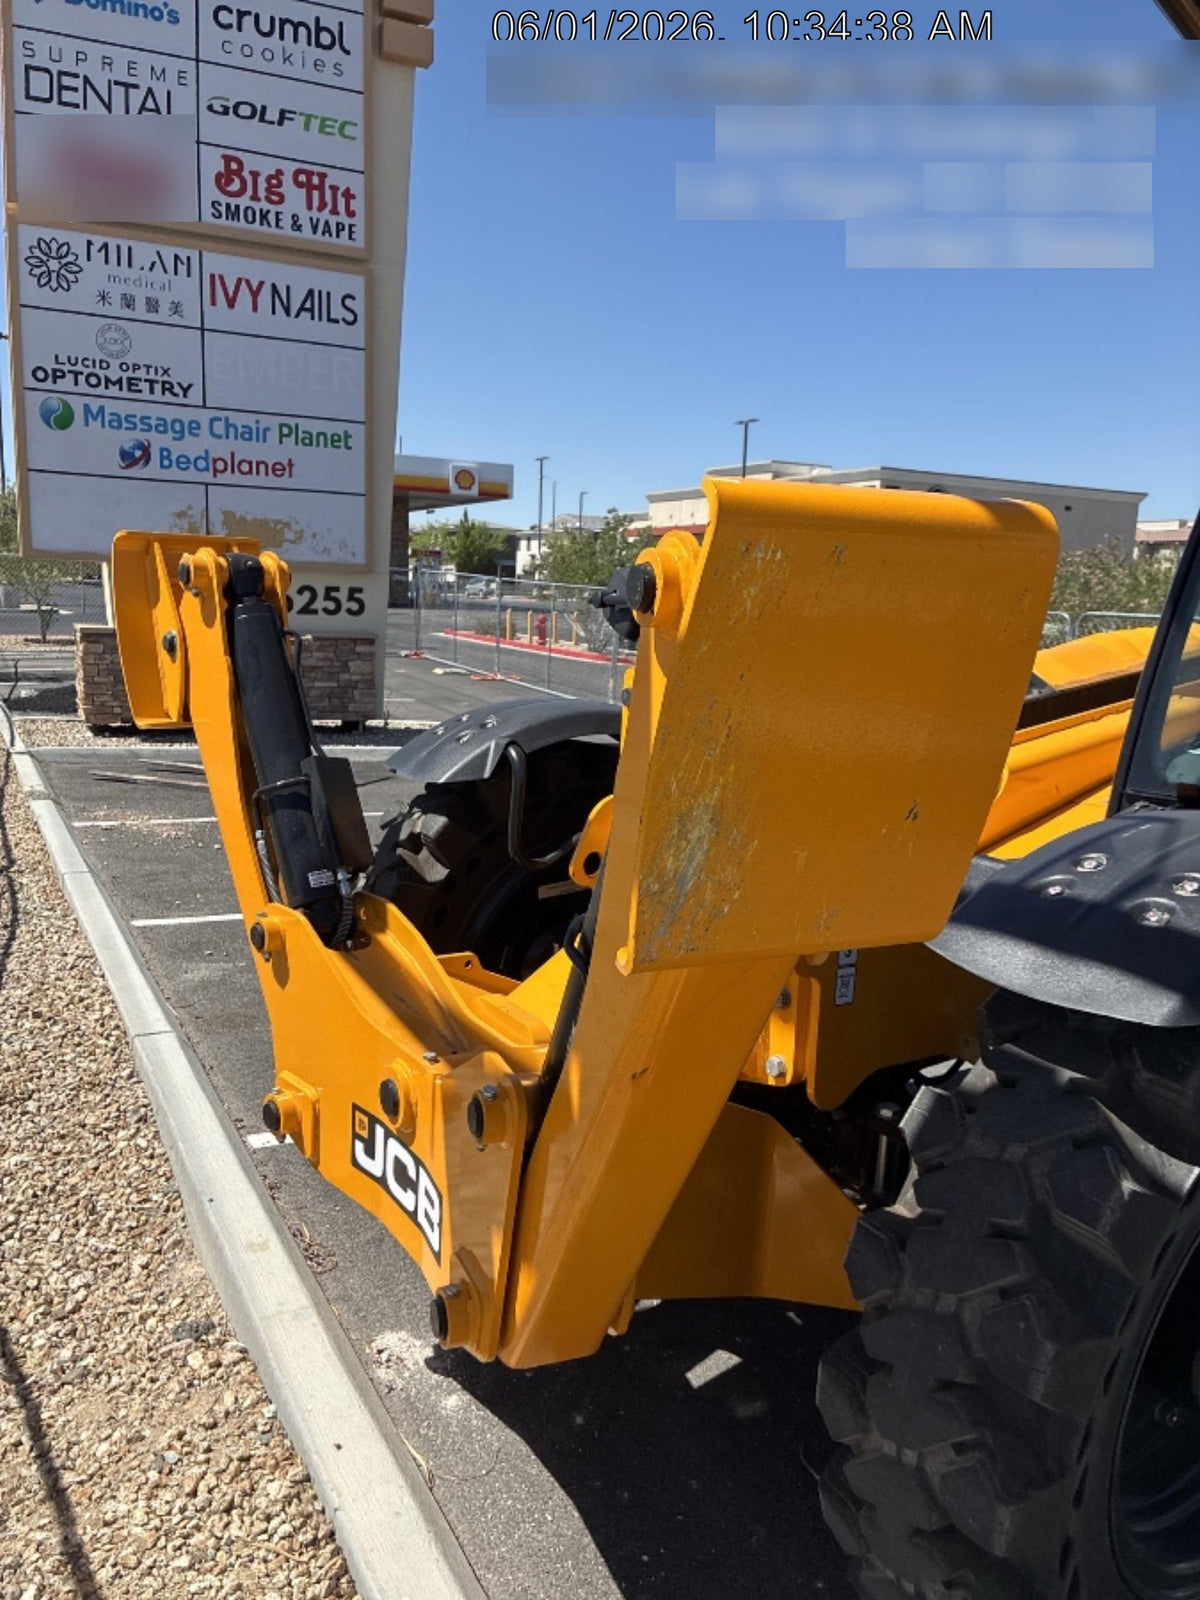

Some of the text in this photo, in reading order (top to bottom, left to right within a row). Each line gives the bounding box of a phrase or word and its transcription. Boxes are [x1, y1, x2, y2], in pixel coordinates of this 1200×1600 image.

[65, 0, 181, 25] omino's
[212, 4, 351, 56] crumbl
[22, 40, 189, 86] SUPREME
[221, 40, 345, 77] cookies
[206, 95, 358, 141] GOLFTEC
[211, 200, 358, 242] SMOKE & VAPE
[86, 238, 192, 278] MILAN
[107, 272, 173, 293] medical
[31, 366, 194, 400] OPTOMETRY
[54, 353, 172, 378] LUCID OPTIX
[83, 403, 354, 451] Massage Chair Planet
[159, 446, 295, 479] Bedplanet
[354, 1122, 441, 1253] JCB
